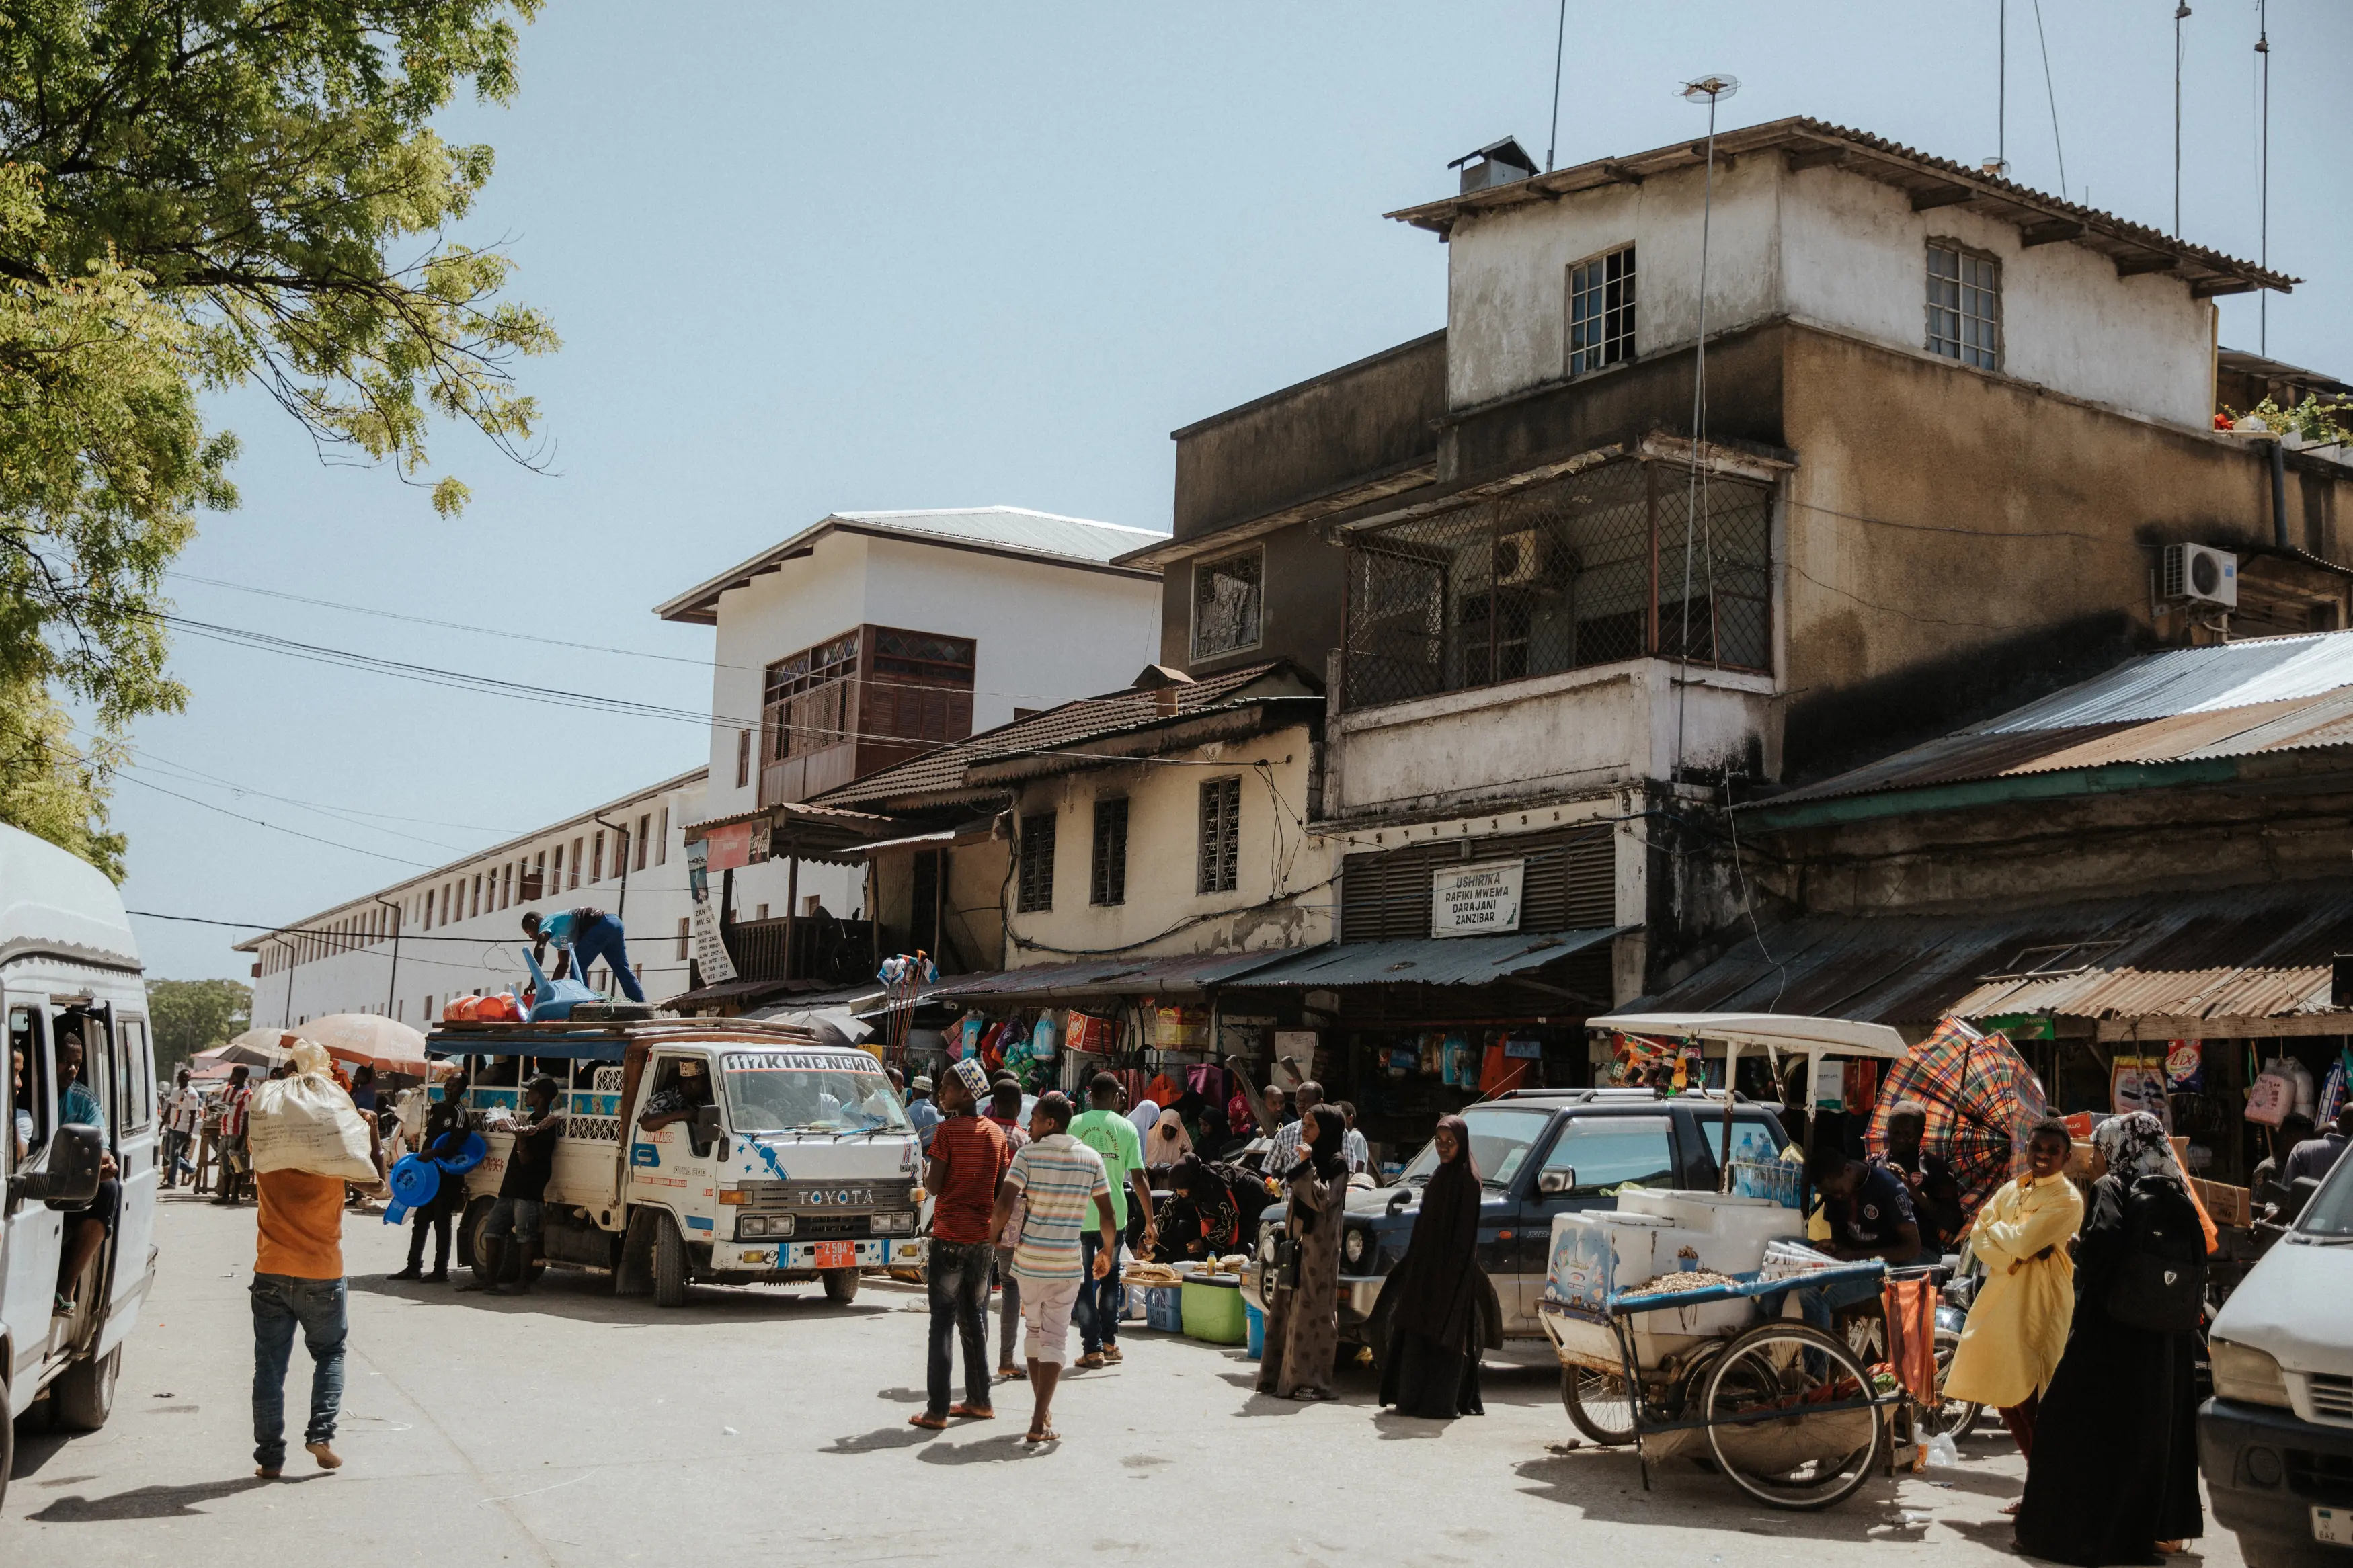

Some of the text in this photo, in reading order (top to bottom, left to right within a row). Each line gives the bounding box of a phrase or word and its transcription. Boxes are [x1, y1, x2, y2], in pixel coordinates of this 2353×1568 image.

[1456, 872, 1500, 888] USHIRIKA
[1445, 886, 1509, 903] RAFIKI MWEMA
[1453, 899, 1496, 913] DARAJANI
[1455, 912, 1495, 925] ZANZIBAR
[727, 1054, 880, 1074] 117 KIWENGWA
[1105, 1130, 1119, 1151] GHAZALI
[674, 1165, 707, 1176] DYNA 200
[900, 1163, 919, 1173] DYNA
[798, 1190, 874, 1205] TOYOTA
[825, 1242, 847, 1254] Z 504
[832, 1253, 842, 1266] EY
[2319, 1531, 2335, 1541] EAZ
